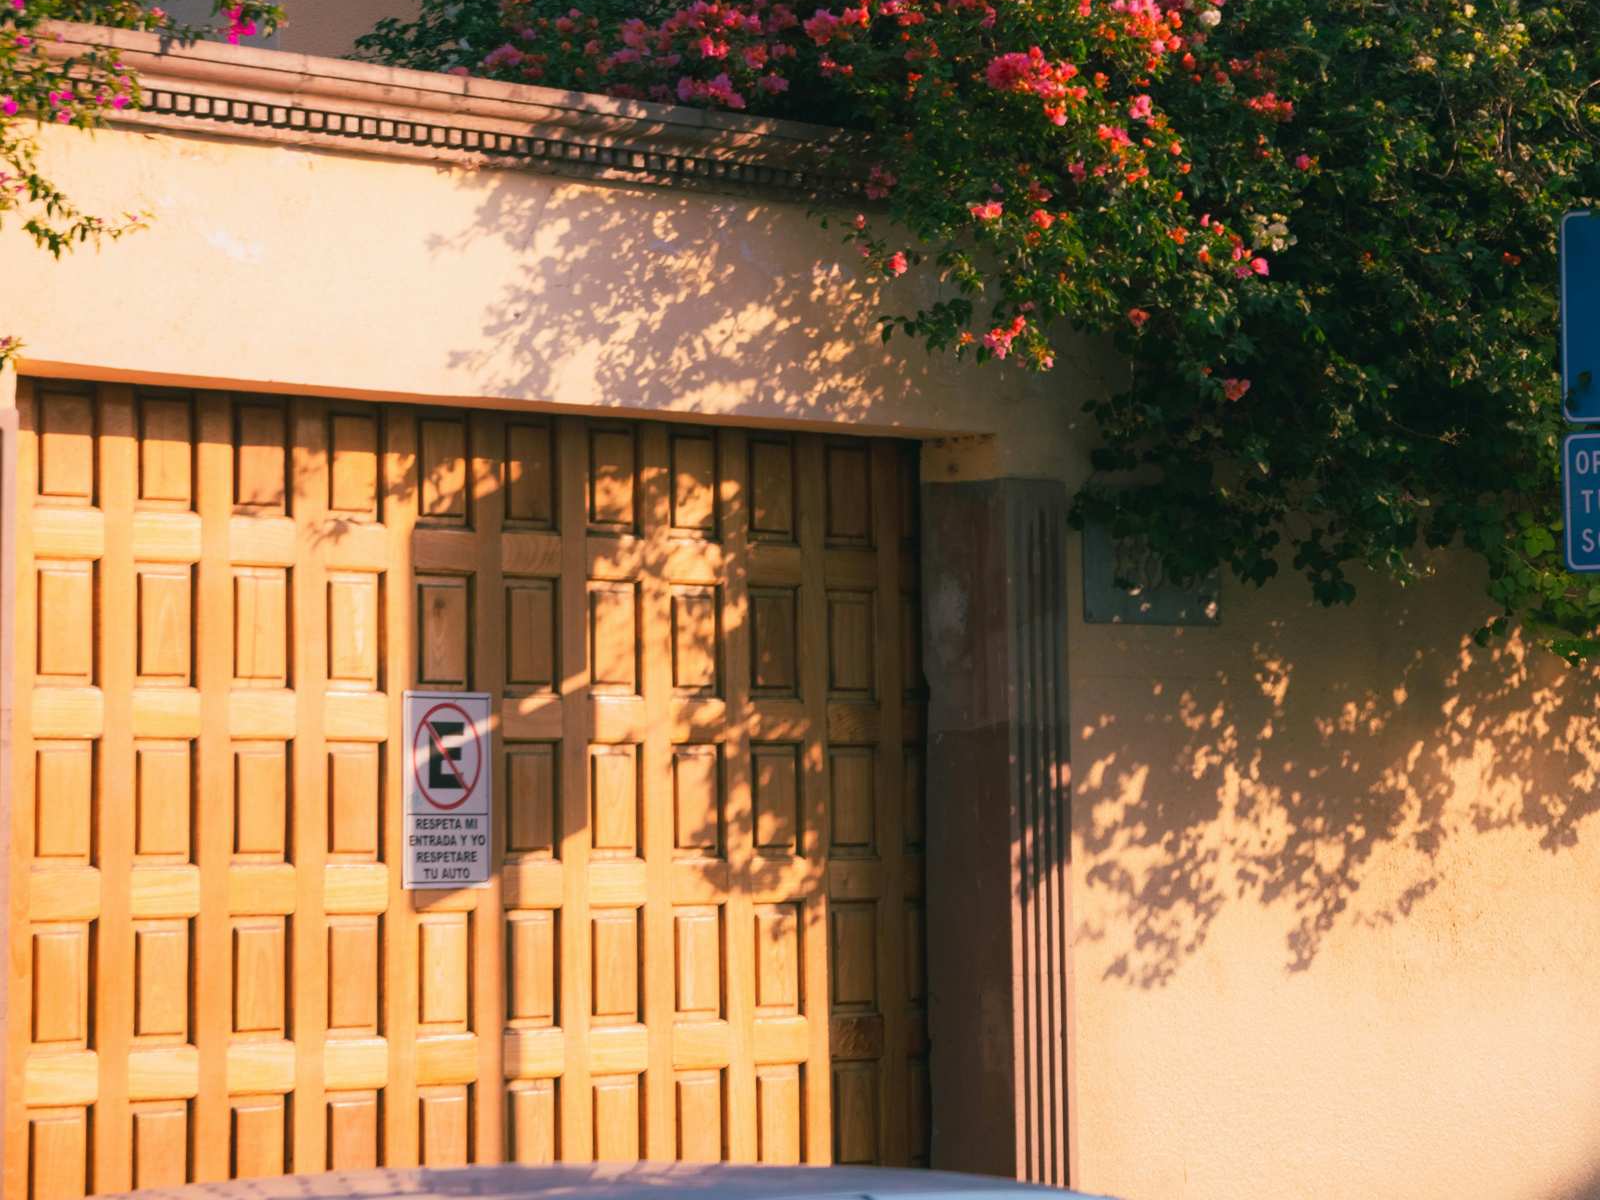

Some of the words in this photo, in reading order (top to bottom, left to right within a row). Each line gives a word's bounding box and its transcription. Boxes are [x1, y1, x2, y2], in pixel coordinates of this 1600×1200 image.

[1581, 489, 1600, 514] T
[1581, 528, 1600, 553] S
[428, 721, 465, 789] E
[415, 818, 462, 830] RESPETA
[464, 818, 479, 830] MI
[409, 834, 457, 847] ENTRADA
[460, 834, 468, 846] Y
[470, 834, 486, 846] YO
[415, 851, 478, 863] RESPETARE
[423, 868, 439, 880] TU
[441, 868, 471, 879] AUTO
